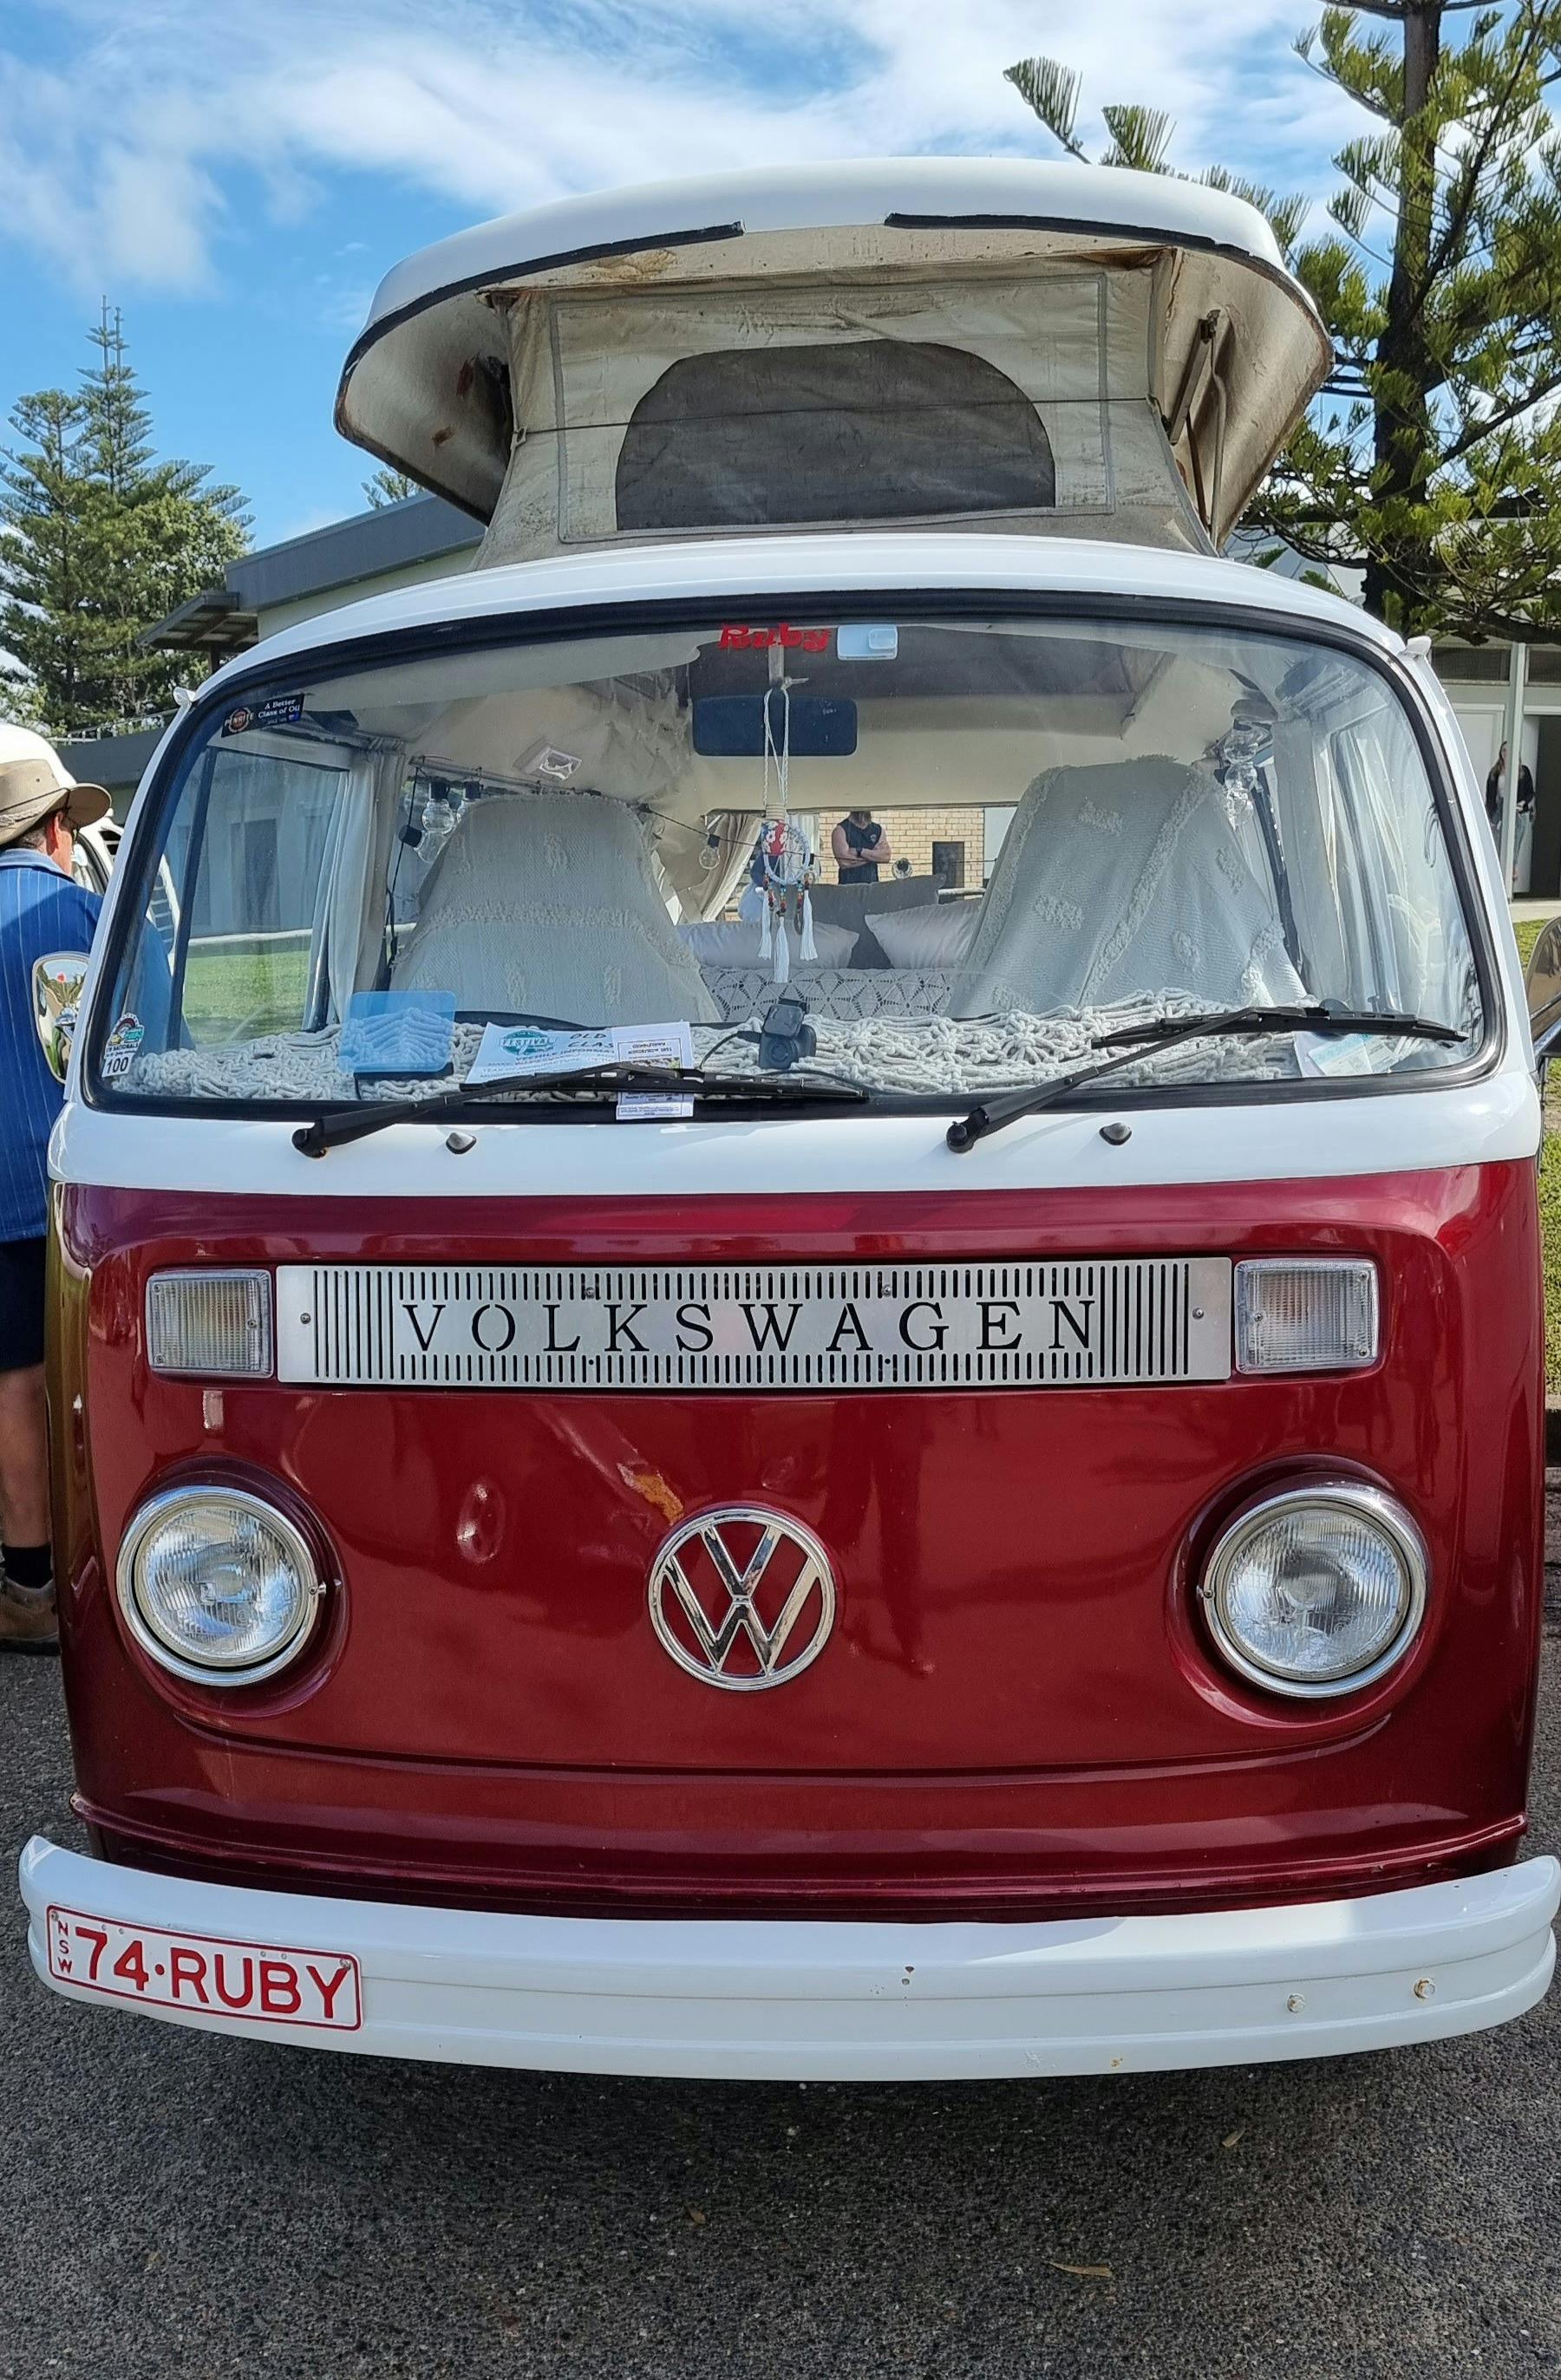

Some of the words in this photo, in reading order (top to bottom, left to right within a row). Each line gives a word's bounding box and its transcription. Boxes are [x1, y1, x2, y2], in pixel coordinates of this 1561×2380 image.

[717, 622, 832, 652] Ruby
[258, 709, 278, 719] Class
[272, 699, 296, 708] Better
[107, 1057, 129, 1073] 100
[402, 1300, 1095, 1353] VOLKSWAGEN
[659, 1519, 825, 1679] VW
[57, 1920, 74, 1975] NSW
